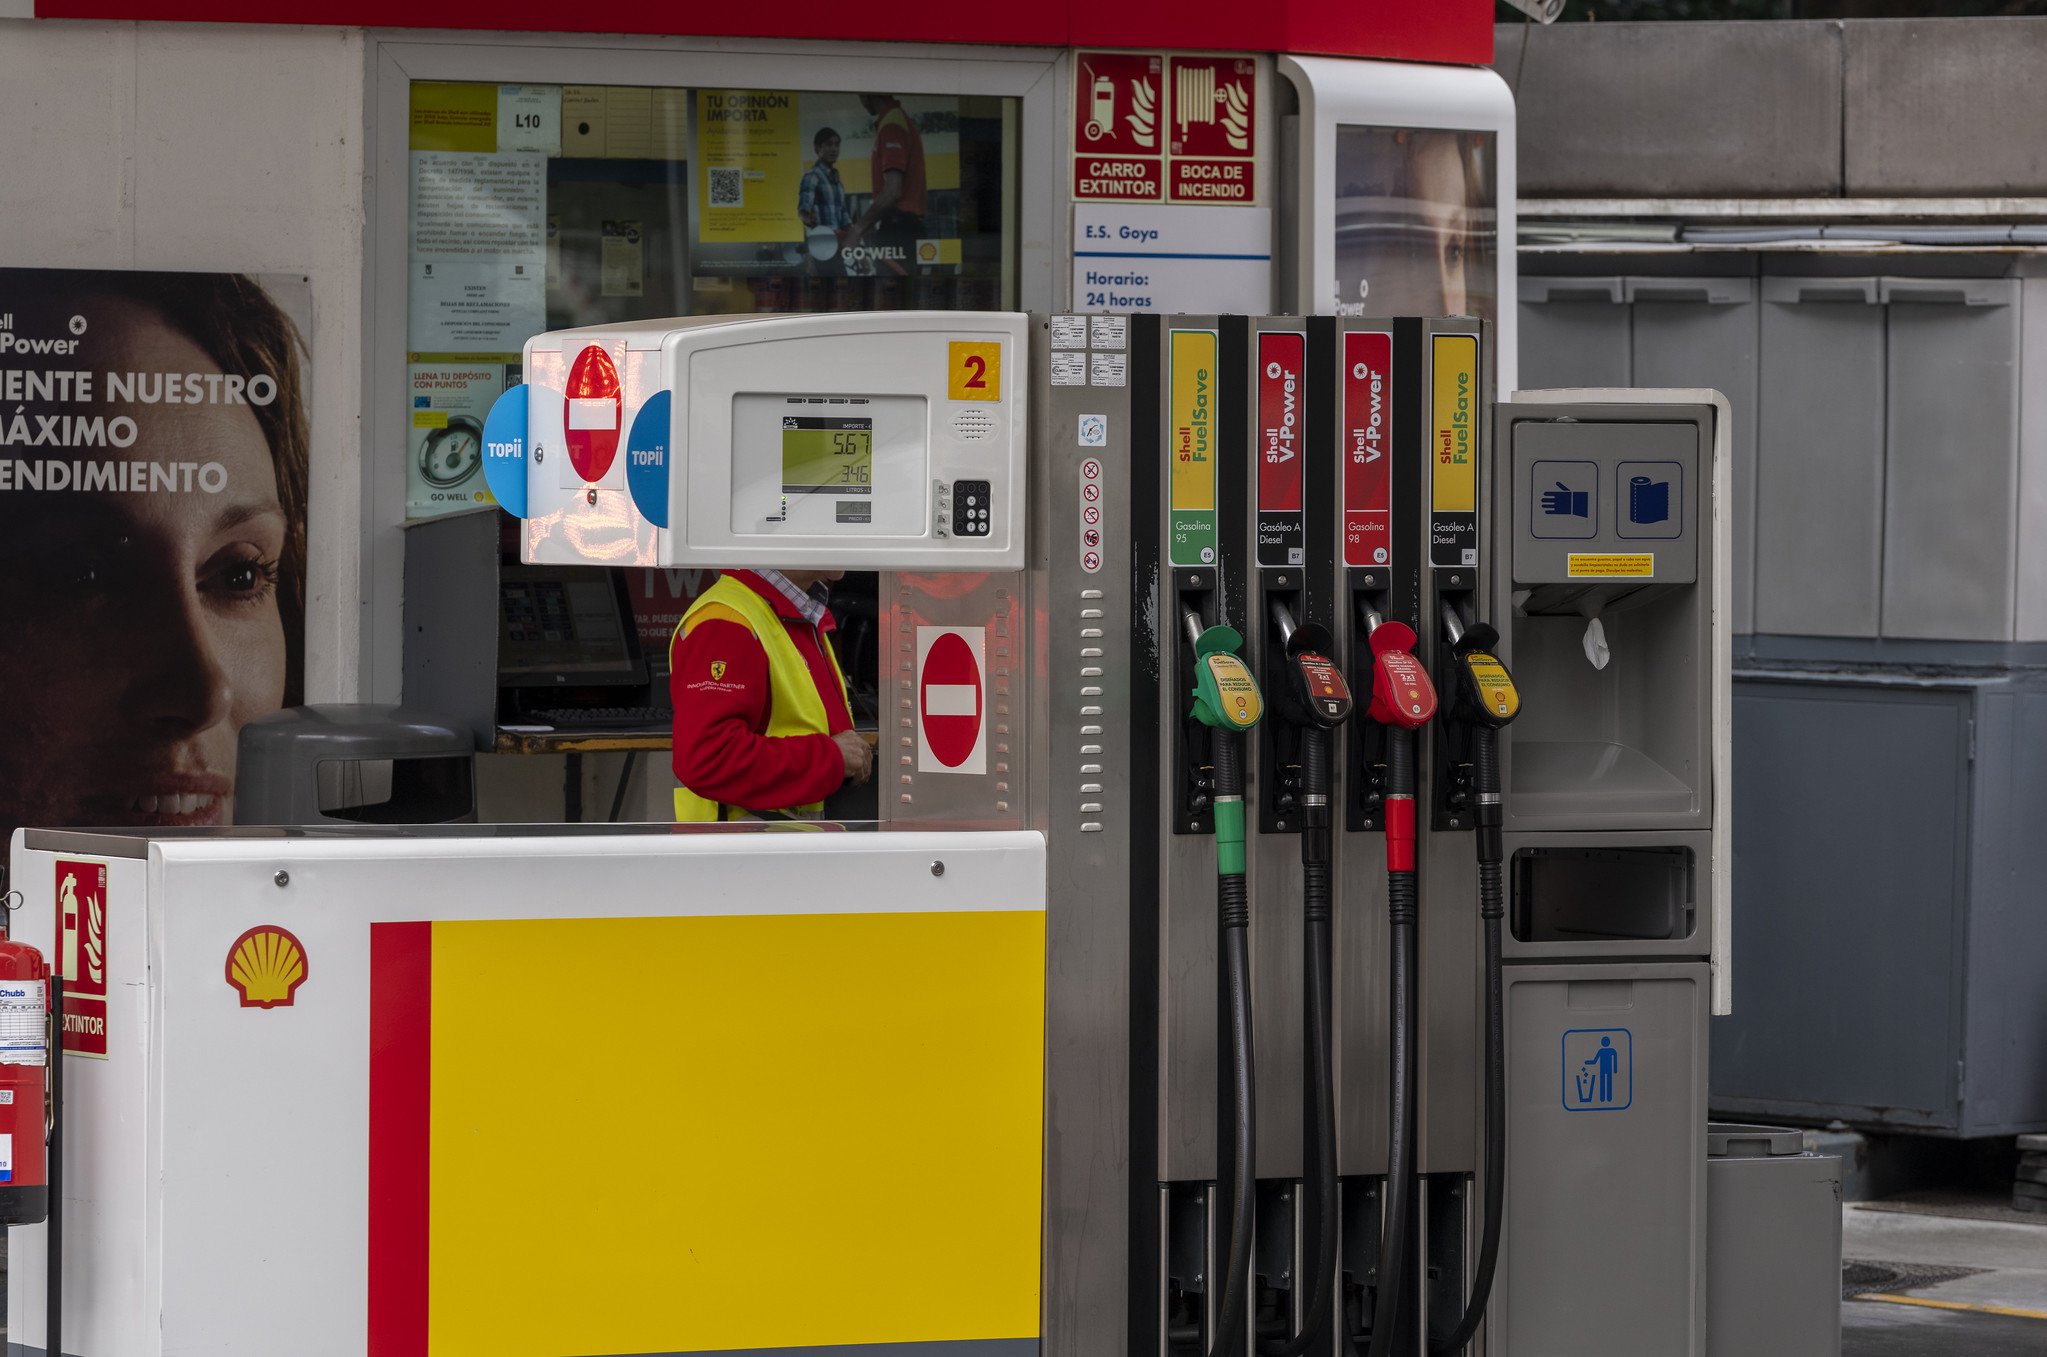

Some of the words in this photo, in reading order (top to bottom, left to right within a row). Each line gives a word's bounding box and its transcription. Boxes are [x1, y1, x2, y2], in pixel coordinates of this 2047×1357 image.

[706, 95, 723, 108] TU
[728, 91, 788, 108] OPINIÓN
[516, 114, 540, 128] L10
[707, 109, 768, 122] IMPORTA
[1090, 162, 1145, 178] CARRO
[1181, 165, 1221, 179] BOCA
[1224, 166, 1242, 180] DE
[1079, 179, 1156, 195] EXTINTOR
[1179, 183, 1245, 197] INCENDIO
[1085, 225, 1110, 239] E.S.
[1119, 225, 1159, 243] Goya
[841, 247, 865, 260] GO
[870, 246, 907, 259] WELL
[1086, 272, 1149, 285] Horario:
[1086, 292, 1105, 306] 24
[1109, 292, 1152, 307] horas
[414, 372, 438, 380] LLENA
[452, 370, 492, 380] DEPÓSITO
[964, 355, 986, 388] 2
[107, 372, 277, 406] NUESTRO
[414, 381, 432, 389] CON
[435, 381, 468, 389] PUNTOS
[1191, 368, 1208, 462] FuelSave
[1279, 370, 1296, 463] V-Power
[1366, 370, 1382, 463] V-Power
[1452, 372, 1469, 465] FuelSave
[1180, 426, 1191, 462] Shell
[1266, 428, 1278, 463] Shell
[1353, 428, 1365, 464] Shell
[1440, 429, 1451, 464] Shell
[431, 493, 444, 501] GO
[447, 493, 468, 501] WELL
[1176, 521, 1211, 531] Gasolina
[1259, 522, 1292, 532] Gasóleo
[1293, 523, 1301, 531] A
[1348, 521, 1384, 531] Gasolina
[1433, 522, 1465, 532] Gasóleo
[1467, 523, 1474, 532] A
[1176, 533, 1187, 543] 95
[1260, 534, 1283, 544] Diesel
[1348, 534, 1360, 543] 98
[1433, 534, 1456, 544] Diesel
[649, 628, 666, 637] QUE
